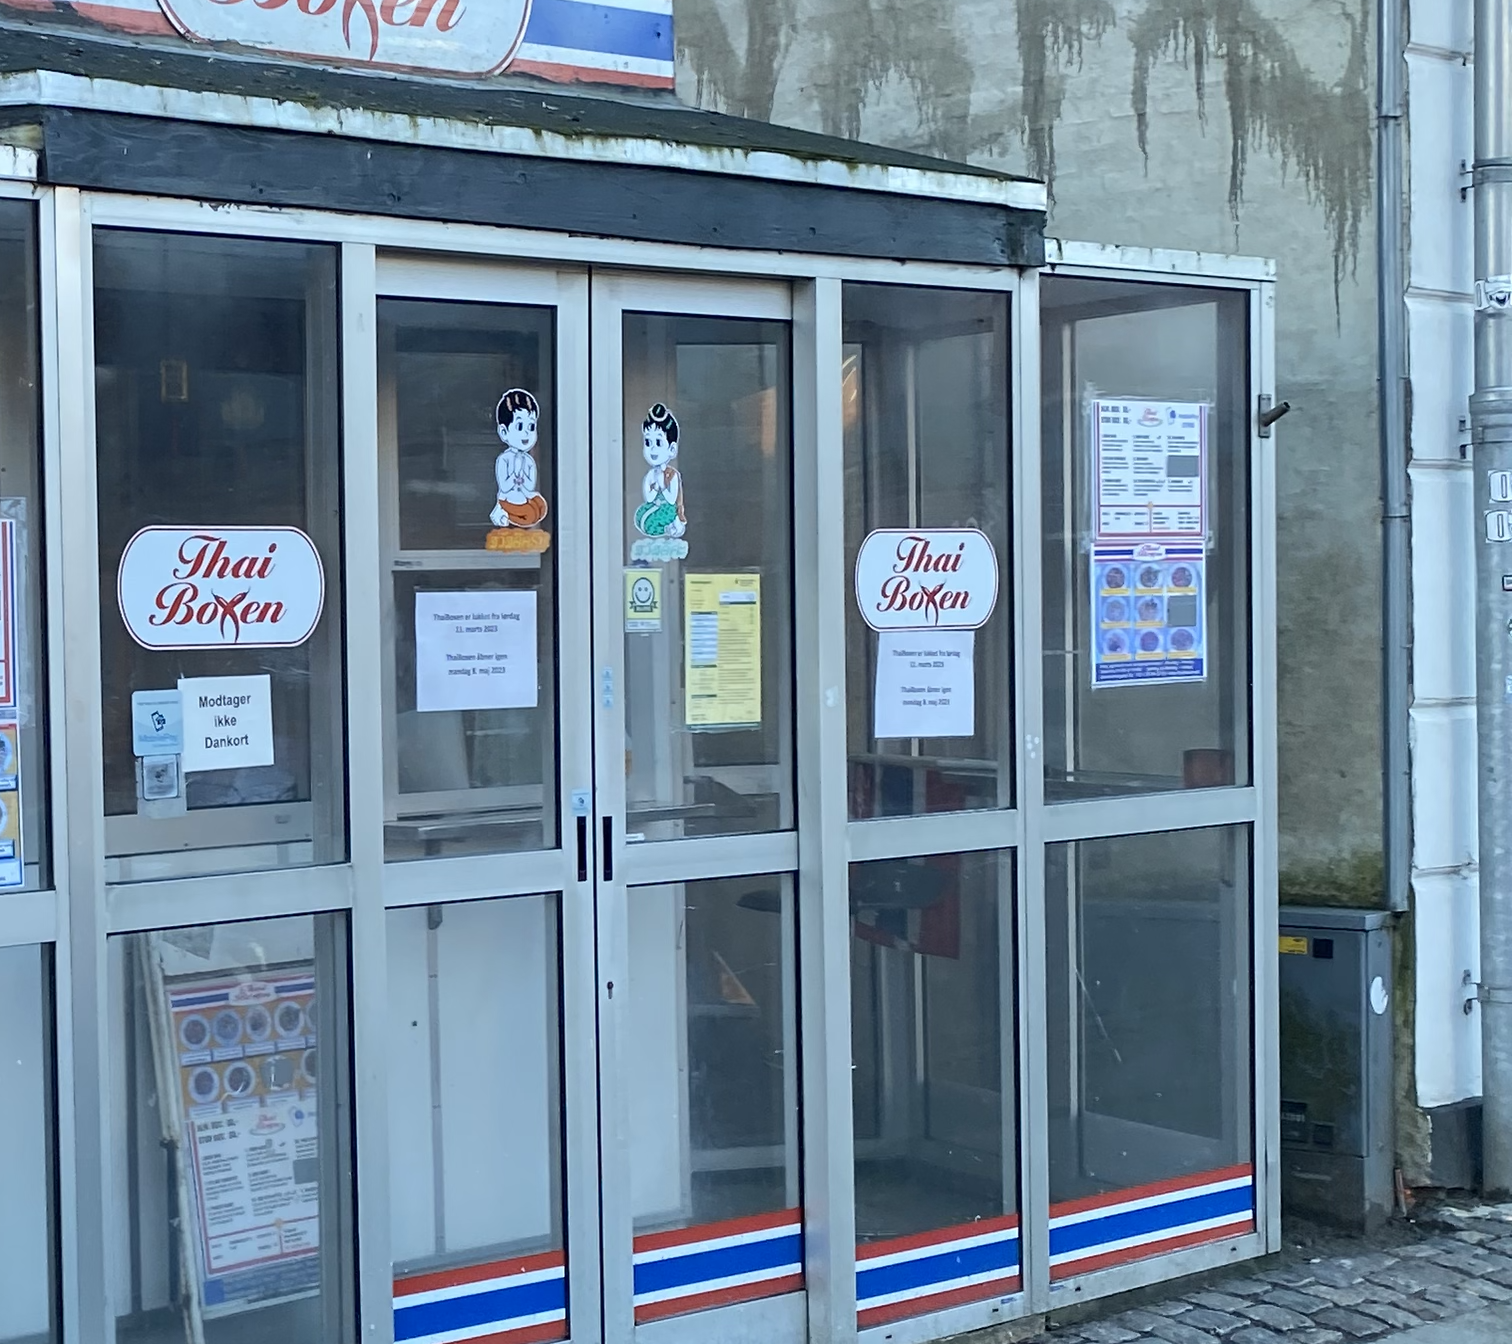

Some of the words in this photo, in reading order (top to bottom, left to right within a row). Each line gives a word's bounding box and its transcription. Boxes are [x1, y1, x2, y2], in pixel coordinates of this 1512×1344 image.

[173, 535, 277, 580] Thai
[893, 536, 965, 573] Thai
[148, 582, 287, 643] Boxen
[876, 575, 971, 626] Boxen
[199, 694, 251, 708] Modtager
[214, 715, 237, 728] ikke
[205, 734, 249, 749] Dankort
